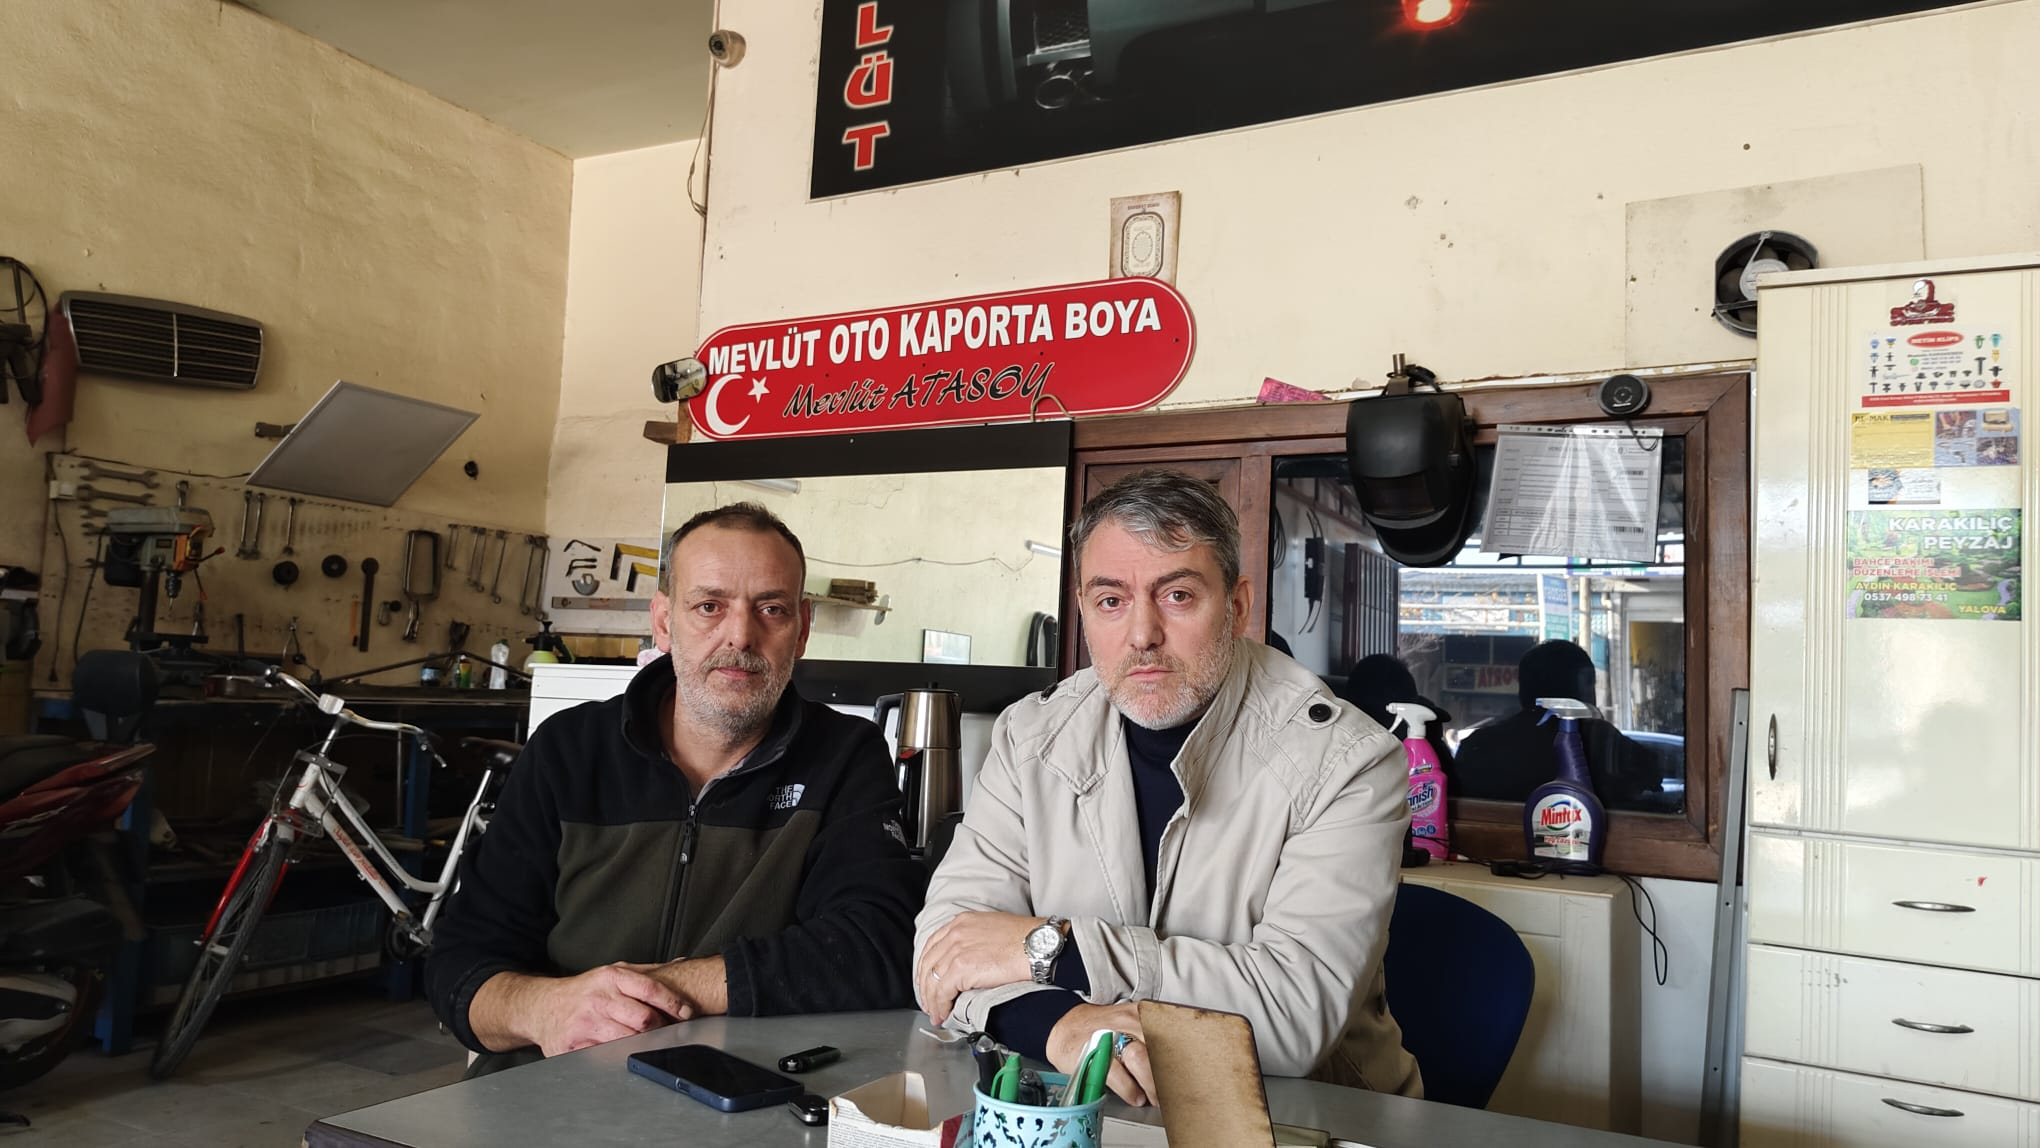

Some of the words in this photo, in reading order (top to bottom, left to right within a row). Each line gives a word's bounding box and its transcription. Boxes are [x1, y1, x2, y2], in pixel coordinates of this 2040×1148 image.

[708, 326, 821, 376] MEVLÜT
[829, 317, 890, 364] OTO
[899, 303, 1054, 357] KAPORTA
[1065, 297, 1161, 340] BOYA
[783, 378, 888, 418] Mevlüt
[887, 361, 1055, 411] ATASOY
[1888, 516, 2012, 531] KARAKILIÇ
[1924, 536, 2013, 549] PEYZAJ
[1856, 582, 1890, 590] AYDIN
[1864, 593, 1891, 601] 0537
[1894, 593, 1916, 601] 498
[1958, 605, 2007, 614] YALOVA
[776, 784, 793, 795] THE
[768, 791, 793, 802] ORTH
[770, 801, 792, 810] FACE
